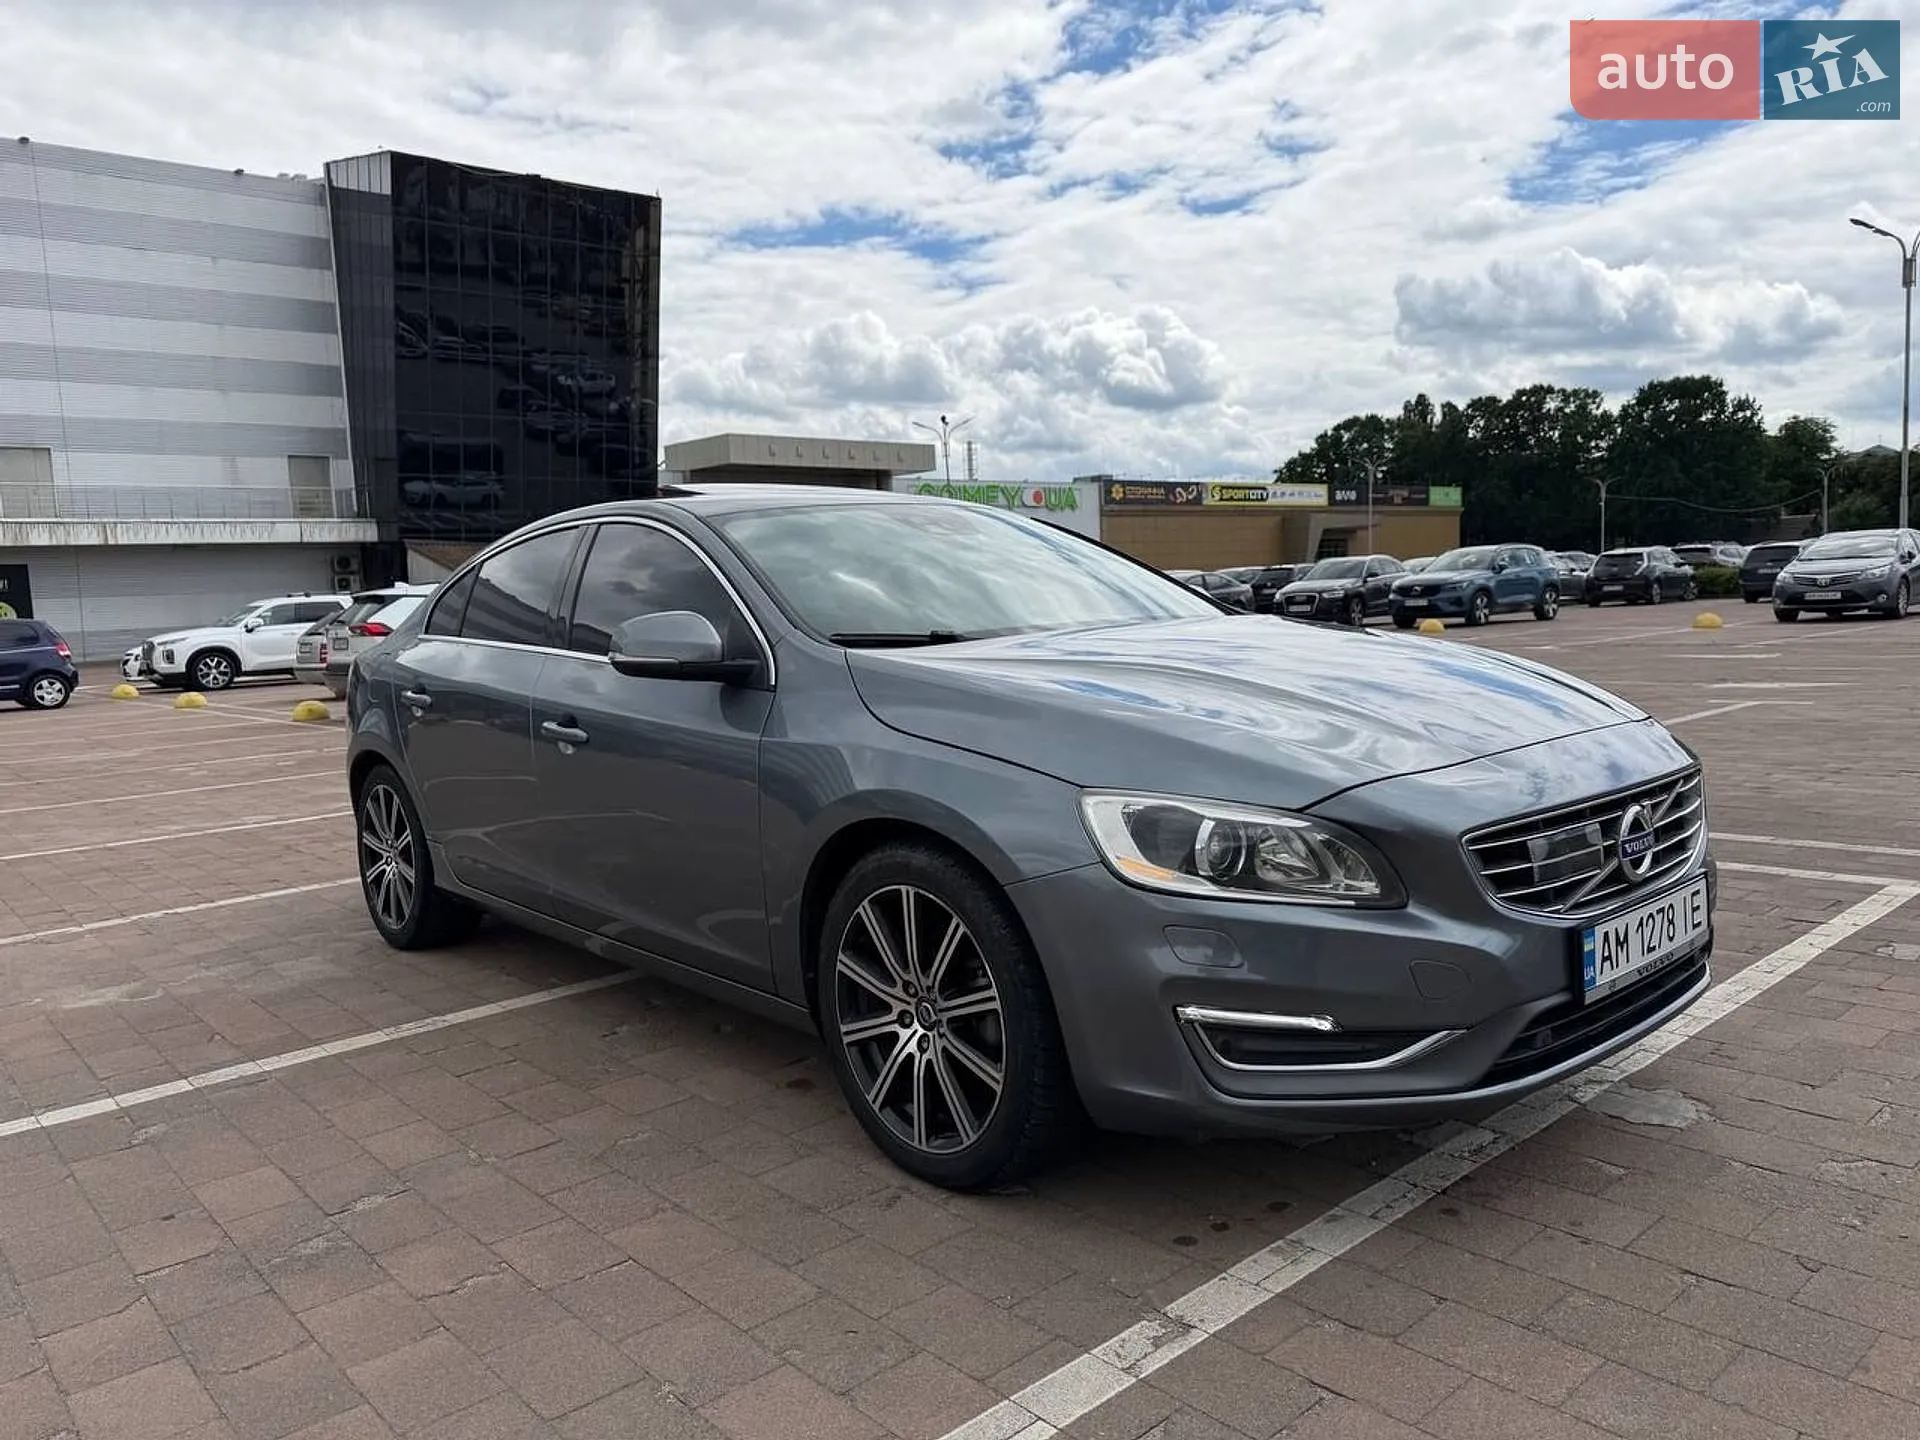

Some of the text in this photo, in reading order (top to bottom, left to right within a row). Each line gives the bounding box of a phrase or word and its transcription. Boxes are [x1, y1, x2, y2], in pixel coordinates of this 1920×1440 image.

[1599, 888, 1703, 975] AM 1278 IE
